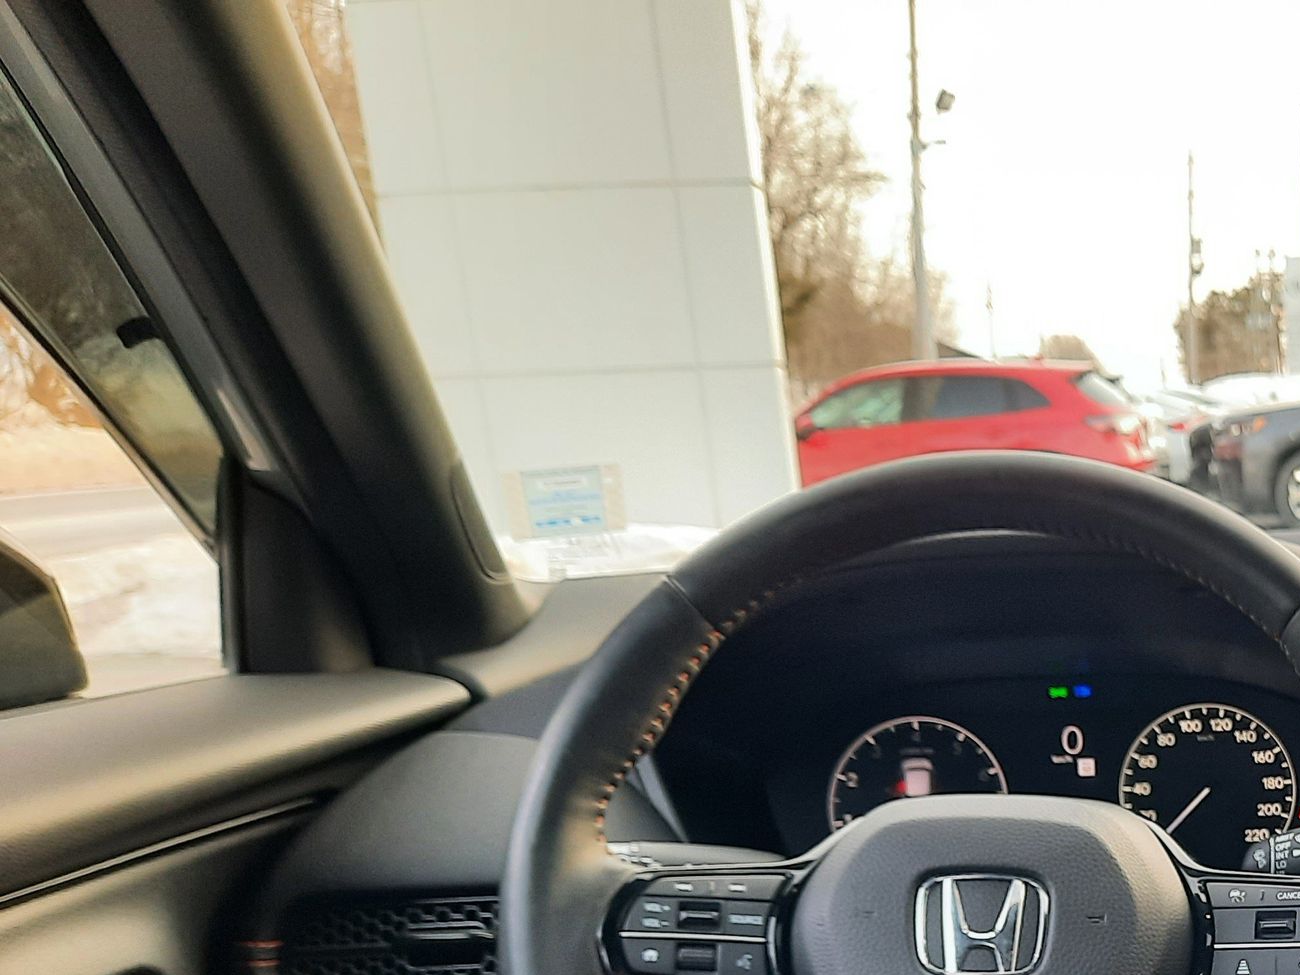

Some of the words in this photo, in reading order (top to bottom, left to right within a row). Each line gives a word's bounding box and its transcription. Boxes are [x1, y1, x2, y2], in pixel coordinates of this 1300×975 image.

[1179, 719, 1202, 733] 100
[1210, 718, 1233, 732] 120
[1060, 725, 1084, 755] 0
[1234, 730, 1258, 743] 140
[1252, 750, 1275, 764] 160
[1262, 776, 1284, 790] 180
[1257, 803, 1282, 816] 200
[1245, 829, 1270, 842] 220
[1276, 841, 1291, 852] OFF
[1276, 850, 1289, 860] INT
[1275, 860, 1286, 870] LO
